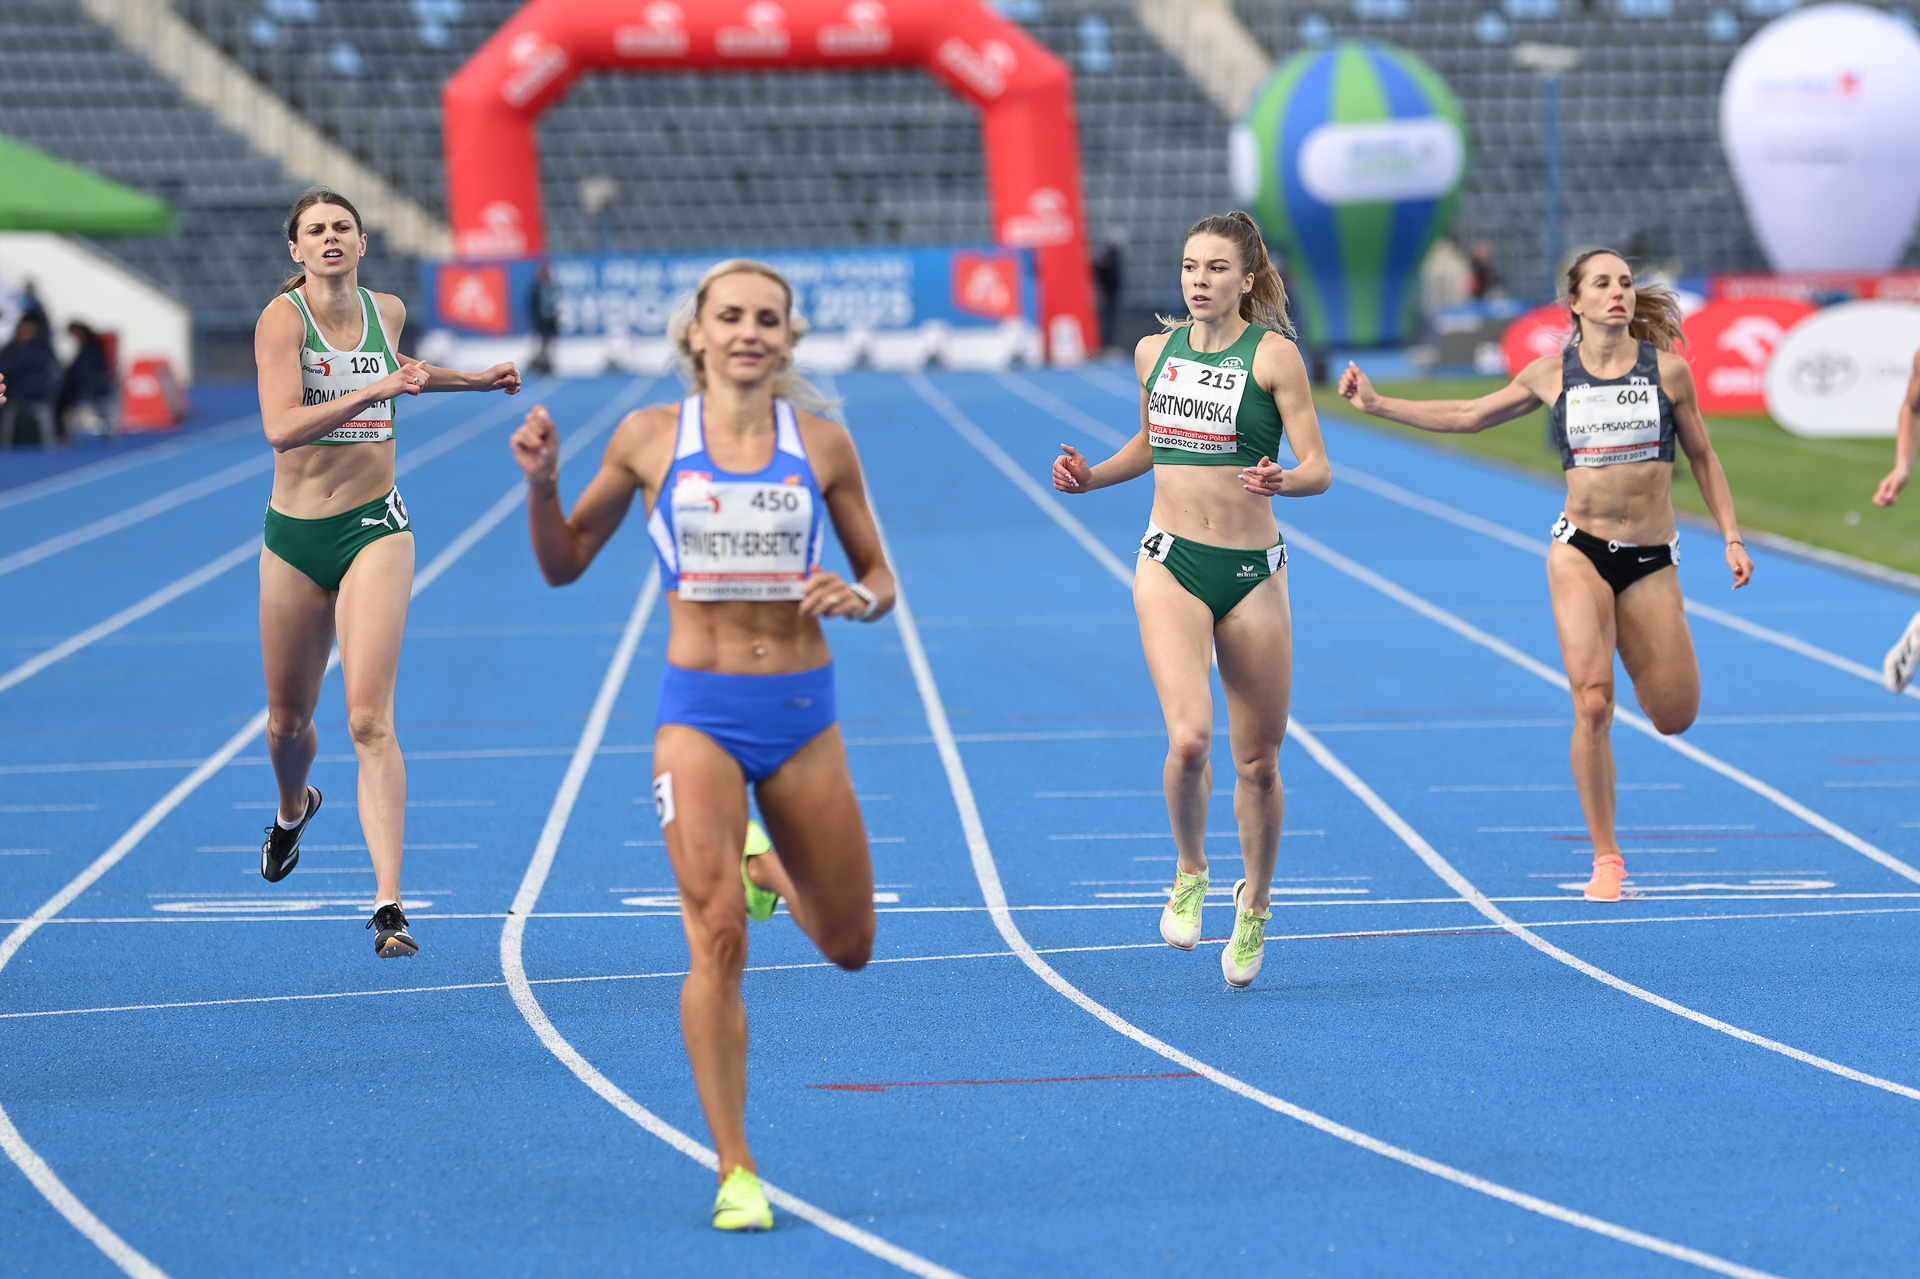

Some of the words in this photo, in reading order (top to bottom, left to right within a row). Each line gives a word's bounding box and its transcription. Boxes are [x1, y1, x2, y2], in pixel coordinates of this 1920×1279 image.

[350, 357, 380, 374] 120
[1198, 369, 1237, 391] 215
[1617, 390, 1649, 405] 604
[1149, 391, 1232, 424] BARTNOWSKA
[327, 431, 357, 439] OSZCZ
[1168, 429, 1208, 440] Mistrzostwa
[1209, 434, 1231, 442] Polski
[1569, 419, 1657, 436] PAŁYS-PISARCZUK
[1200, 442, 1223, 451] 2025
[751, 490, 798, 512] 450
[1553, 517, 1568, 538] 3
[1143, 532, 1164, 558] 4
